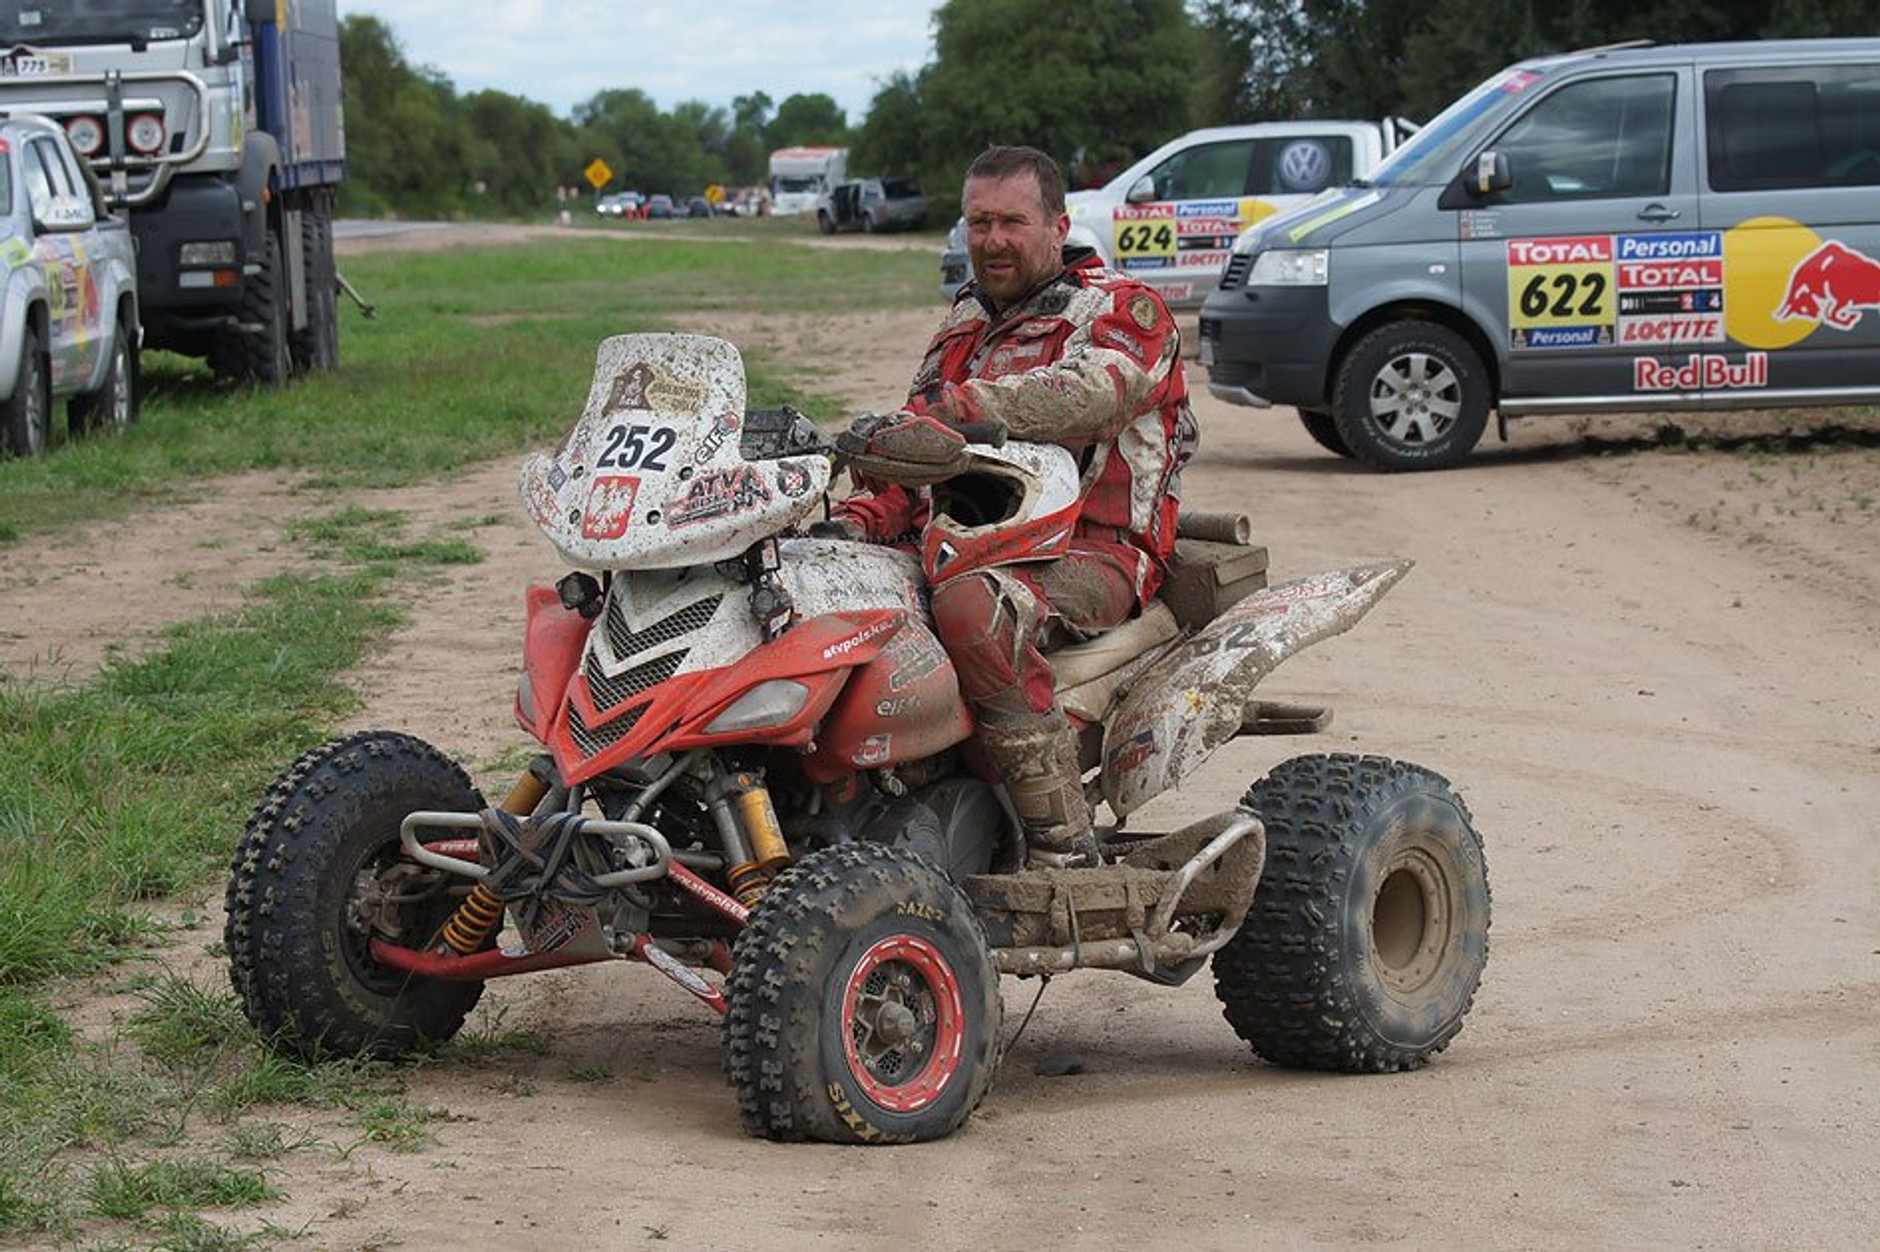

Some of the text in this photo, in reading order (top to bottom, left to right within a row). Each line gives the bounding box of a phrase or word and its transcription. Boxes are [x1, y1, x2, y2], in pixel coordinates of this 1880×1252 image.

[1117, 206, 1171, 220] TOTAL
[1179, 203, 1236, 218] Personal
[1181, 220, 1236, 234] TOTAL
[1118, 225, 1172, 252] 624
[1622, 235, 1716, 256] Personal
[1181, 253, 1229, 267] LOCTIT
[1510, 242, 1610, 263] TOTAL
[1622, 264, 1718, 285] TOTAL
[1520, 272, 1606, 318] 622
[1531, 329, 1594, 344] Personal
[1623, 319, 1718, 341] LOCTITE
[1634, 351, 1767, 391] Red Bull
[596, 424, 677, 472] 252
